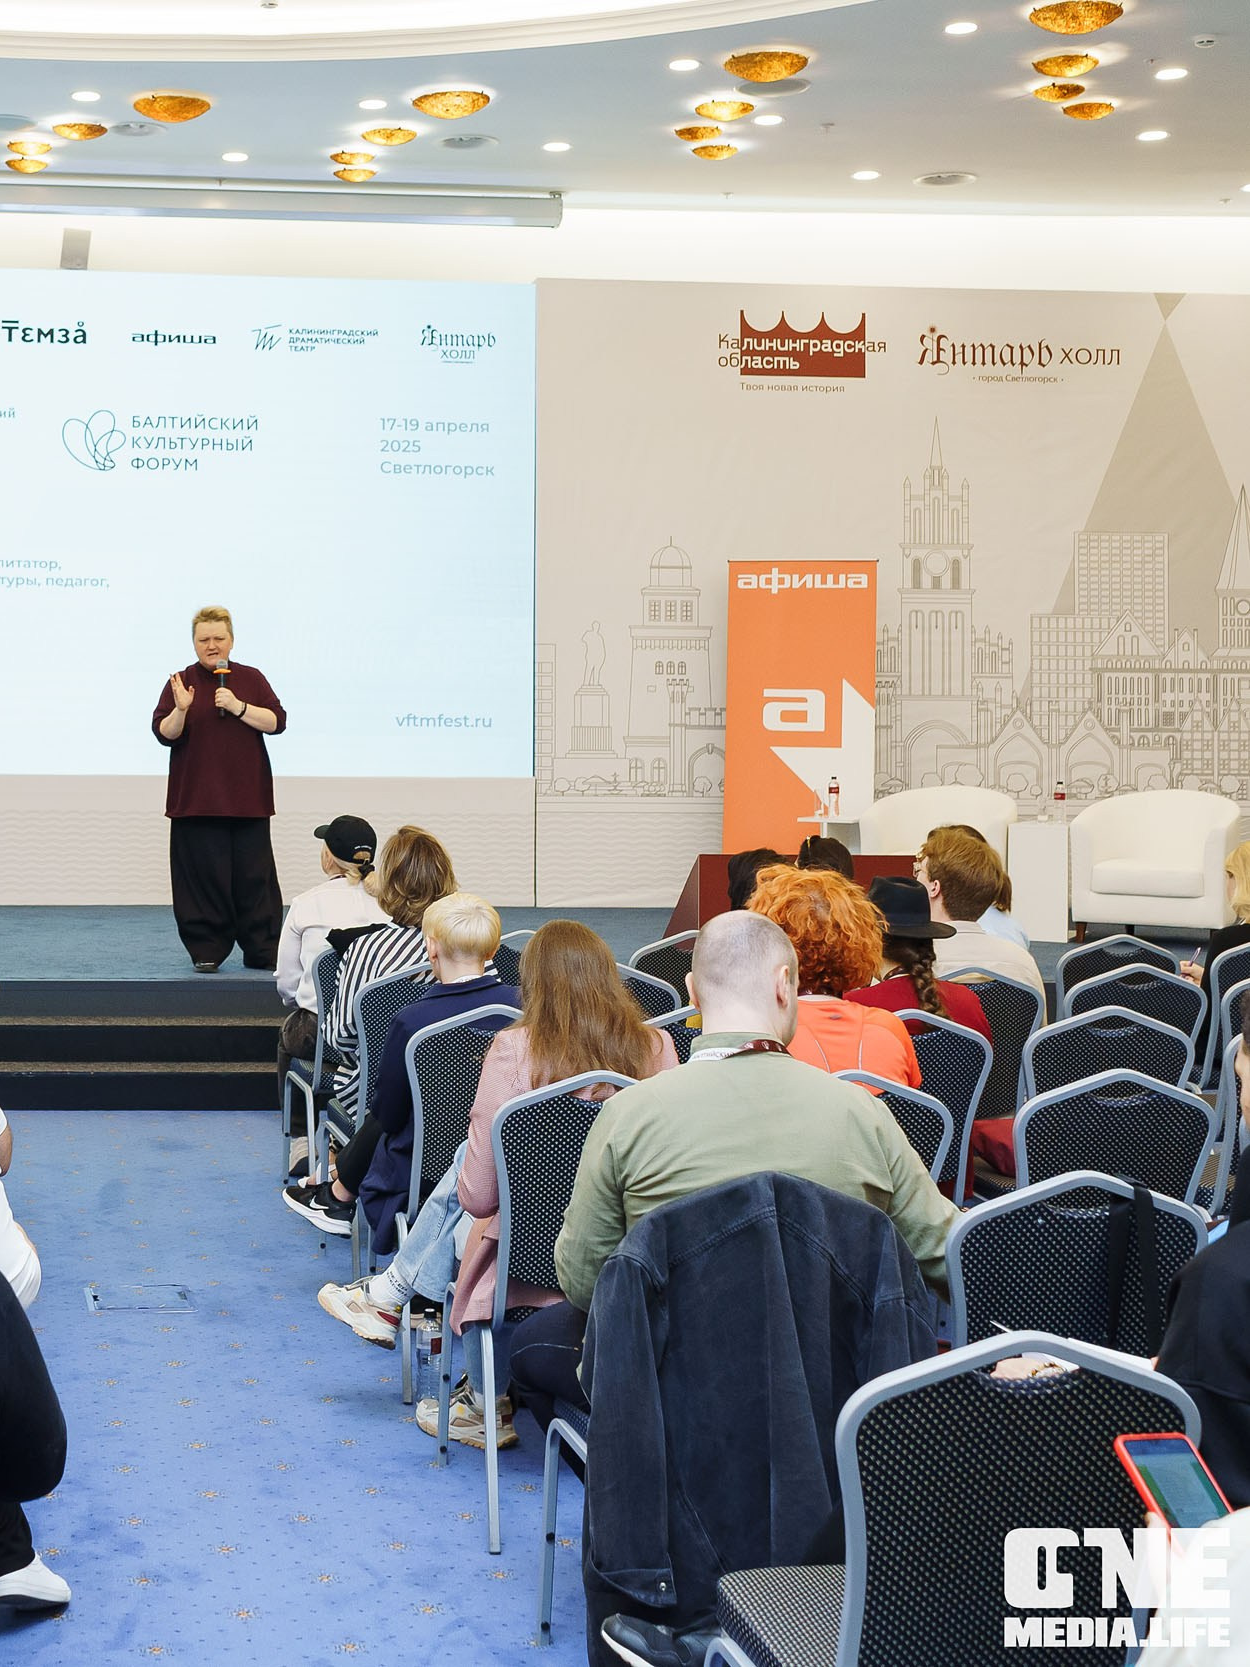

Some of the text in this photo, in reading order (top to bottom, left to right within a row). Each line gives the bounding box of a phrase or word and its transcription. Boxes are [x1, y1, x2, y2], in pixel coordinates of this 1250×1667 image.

[131, 324, 217, 346] афиша
[288, 328, 379, 337] КАЛИНИНГРАДСКИЙ
[288, 337, 365, 345] ДРАМАТИЧЕСКИЙ
[717, 333, 887, 355] Калининградская
[917, 328, 1053, 375] Янтарь
[717, 352, 800, 371] область
[978, 373, 1058, 385] город Светлогорск
[739, 382, 846, 395] Твоя новая история
[131, 414, 260, 431] БАЛТИЙСКИЙ
[379, 417, 490, 435] 17-19 апреля
[131, 435, 254, 452] КУЛЬТУРНЫЙ
[379, 439, 422, 453] 2025
[130, 456, 199, 472] ФОРУМ
[379, 460, 496, 479] Светлогорск
[45, 576, 111, 591] педагог,
[737, 567, 868, 595] афиша
[395, 713, 493, 728] vftmfest.ru
